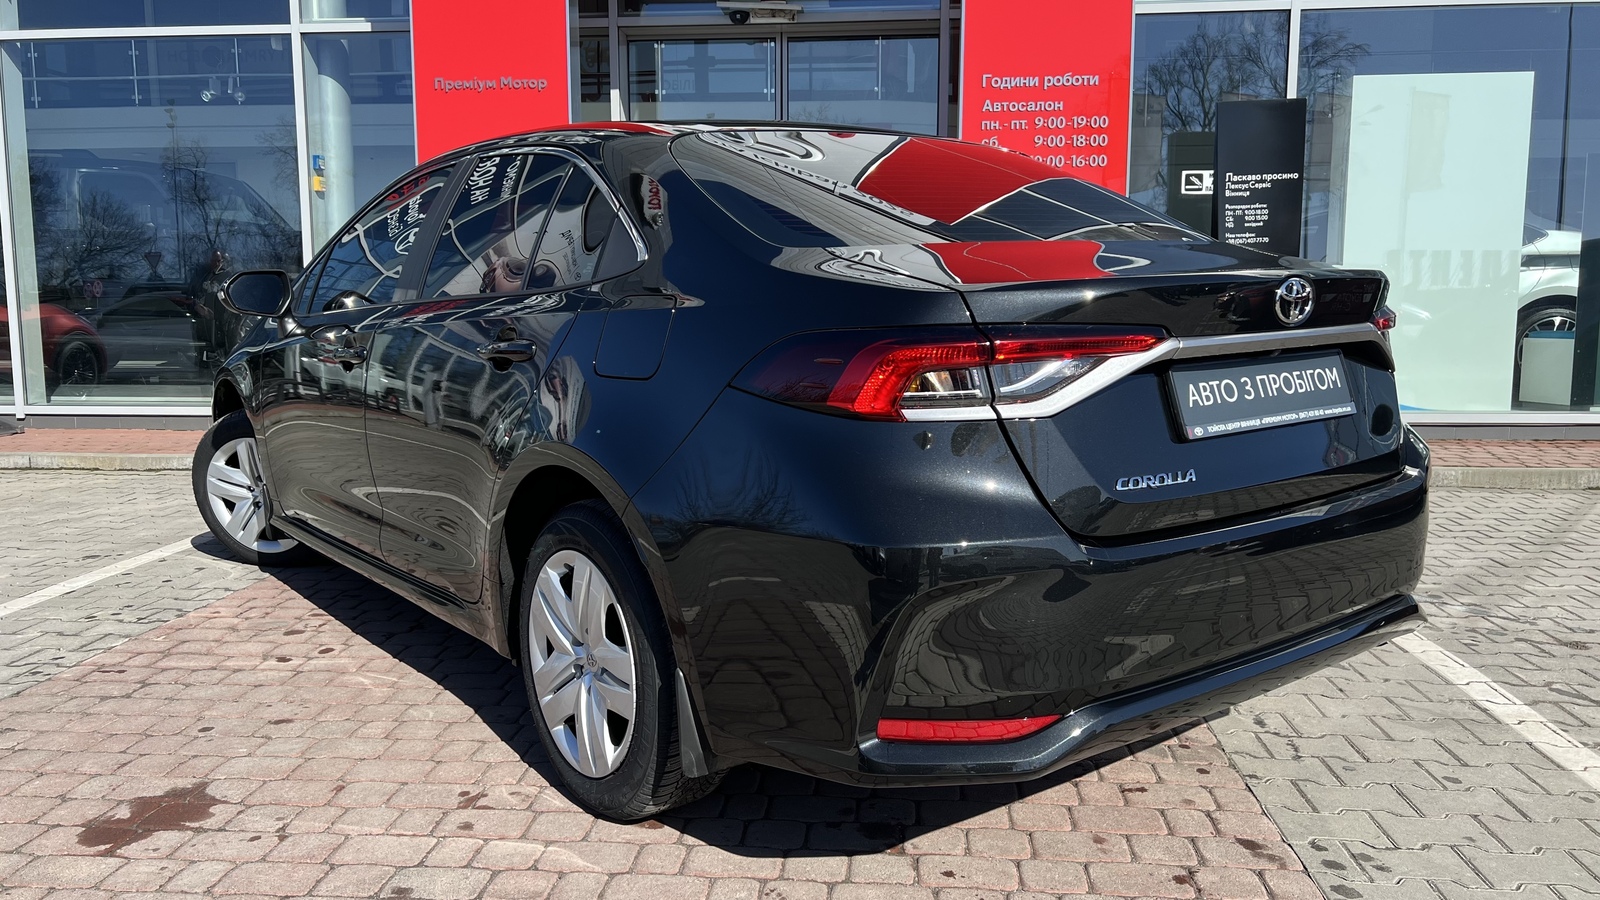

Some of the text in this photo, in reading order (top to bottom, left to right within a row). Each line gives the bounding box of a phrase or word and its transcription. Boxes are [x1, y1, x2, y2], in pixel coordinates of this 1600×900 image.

[434, 76, 547, 92] Преміум Мотор
[982, 72, 1099, 90] Години роботи
[982, 100, 1064, 112] Автосалон
[1034, 115, 1109, 129] 9:00-19:00
[1034, 134, 1108, 147] 9:00-18:00
[1225, 172, 1261, 182] Ласкаво
[1262, 172, 1299, 182] просимо
[1225, 181, 1271, 190] Лексус Сервіс
[1189, 379, 1239, 408] АВТО
[1256, 366, 1342, 398] ПРОБІГОМ
[1116, 469, 1197, 491] COROLLA
